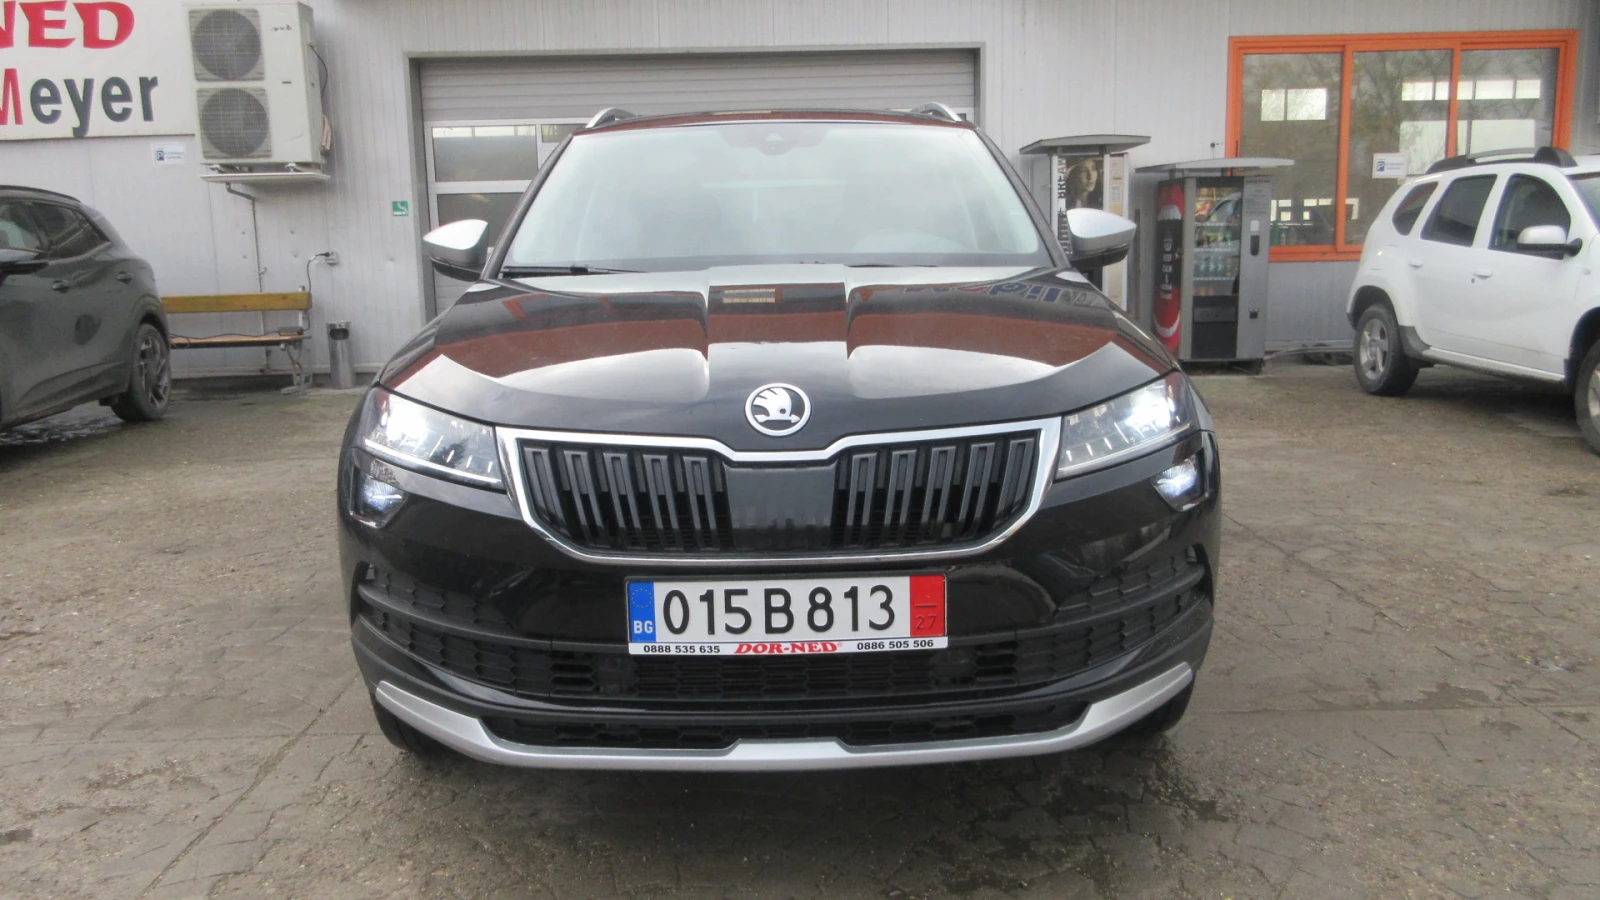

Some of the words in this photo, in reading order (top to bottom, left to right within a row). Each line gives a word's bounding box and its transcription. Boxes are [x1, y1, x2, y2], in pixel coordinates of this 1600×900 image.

[633, 620, 653, 634] BG
[916, 614, 936, 630] 27
[643, 645, 671, 653] 0888
[675, 645, 696, 653] 535
[699, 645, 720, 653] 635
[857, 642, 885, 650] 0886
[889, 641, 909, 649] 505
[913, 639, 934, 648] 506
